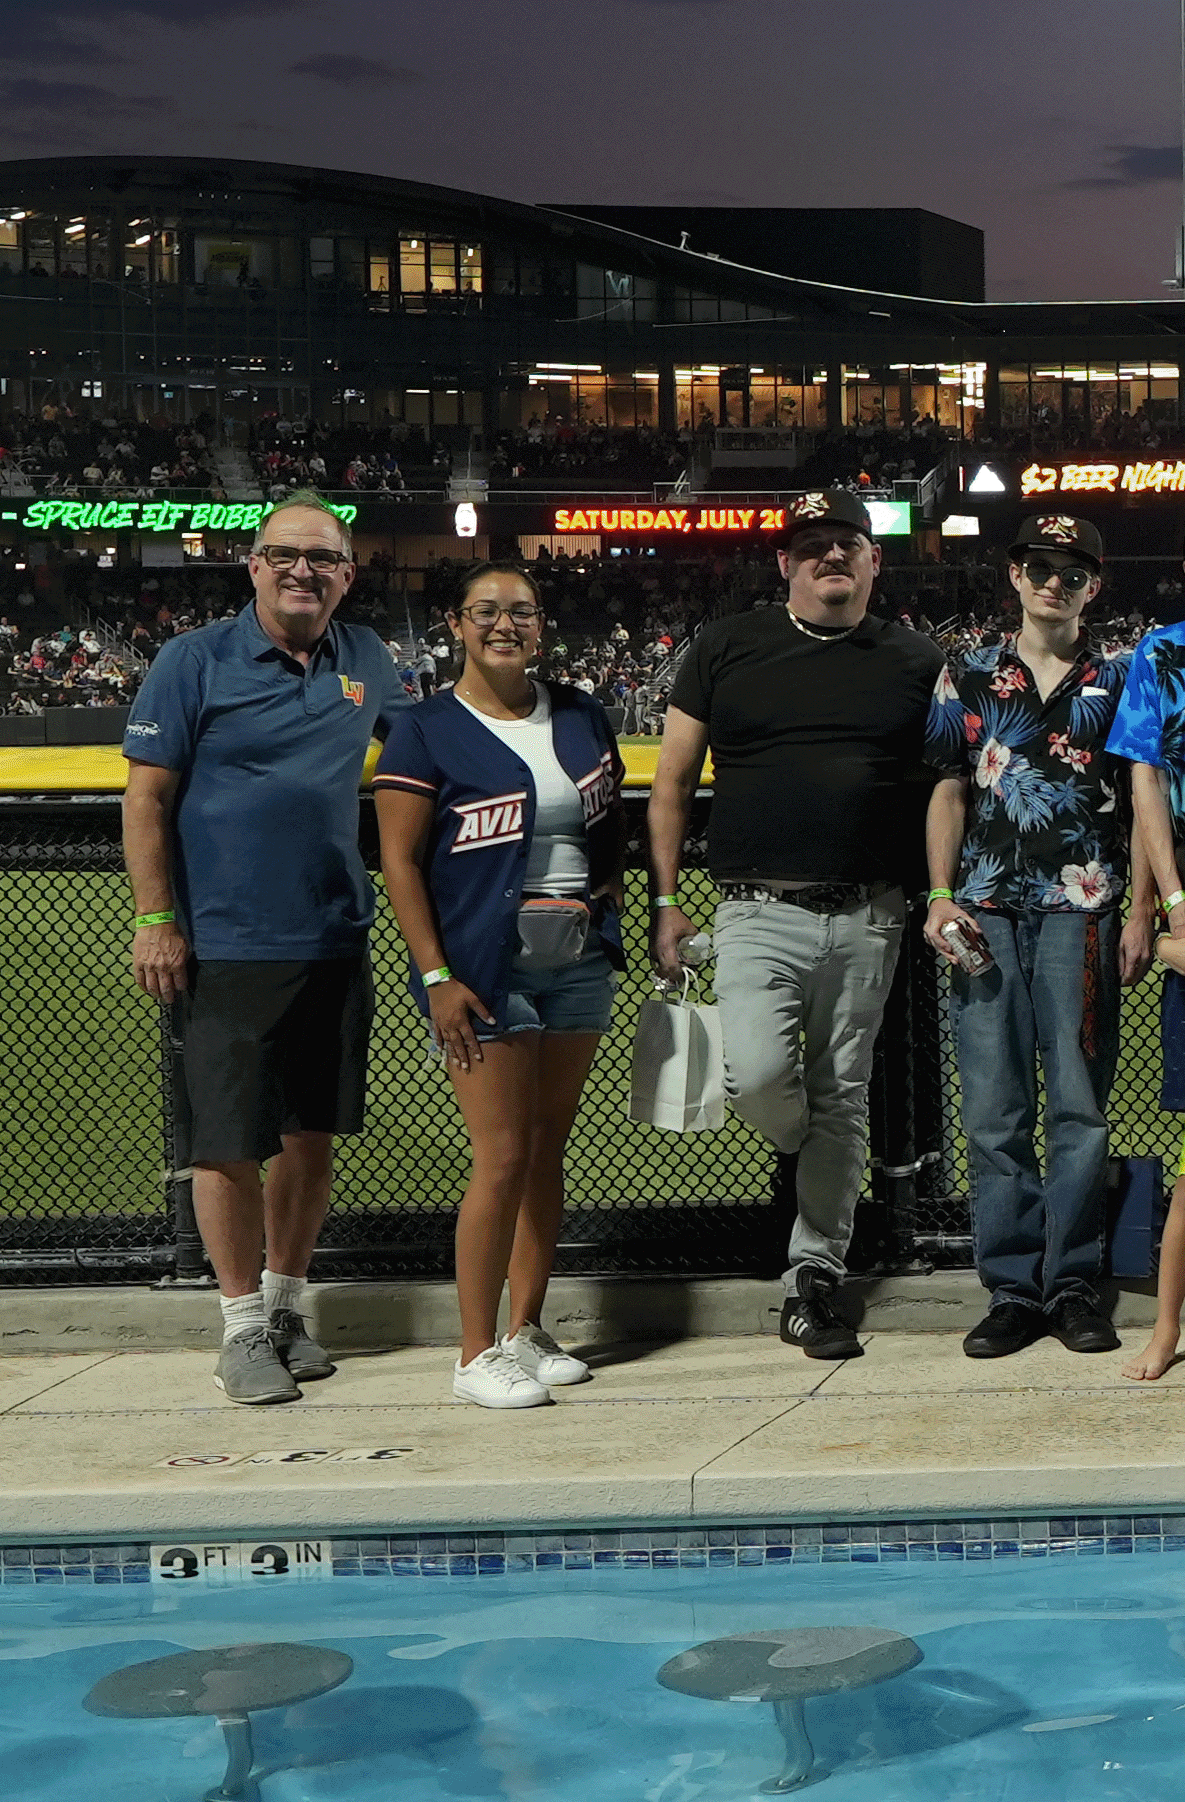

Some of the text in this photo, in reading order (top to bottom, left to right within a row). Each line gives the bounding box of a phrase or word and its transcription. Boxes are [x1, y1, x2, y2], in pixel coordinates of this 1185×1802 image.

[1021, 463, 1057, 494] $2
[1060, 464, 1119, 492] BEER
[22, 500, 139, 530] SPRUCE
[137, 500, 191, 532] ELF
[554, 508, 691, 533] SATURDAY,
[695, 508, 752, 531] JULY
[160, 1542, 322, 1579] 3 FT 3 IN
